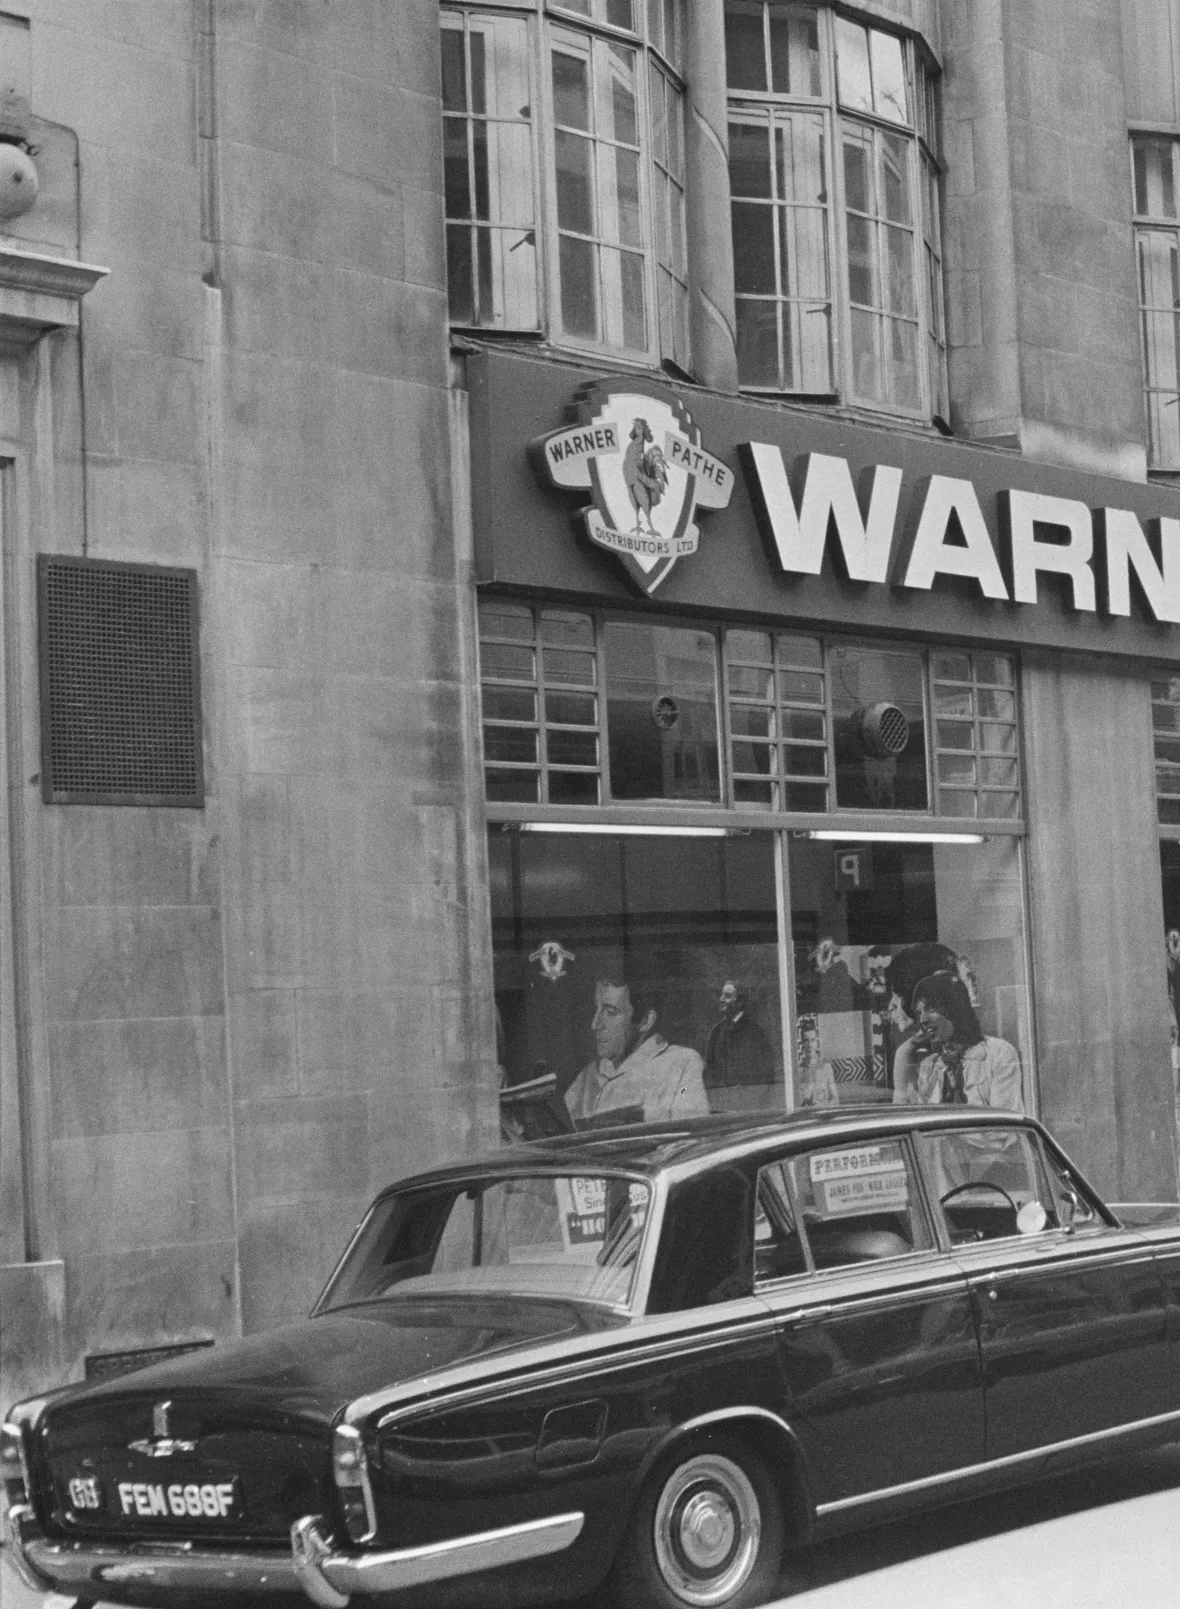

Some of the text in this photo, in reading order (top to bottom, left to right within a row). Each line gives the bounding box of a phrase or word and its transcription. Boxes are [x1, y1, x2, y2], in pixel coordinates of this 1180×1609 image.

[548, 428, 616, 464] WARNER
[671, 440, 727, 488] PATHE
[595, 527, 694, 555] DISTRIBUTORS LTD
[69, 1477, 99, 1508] GB
[118, 1483, 234, 1516] FEN 688F
